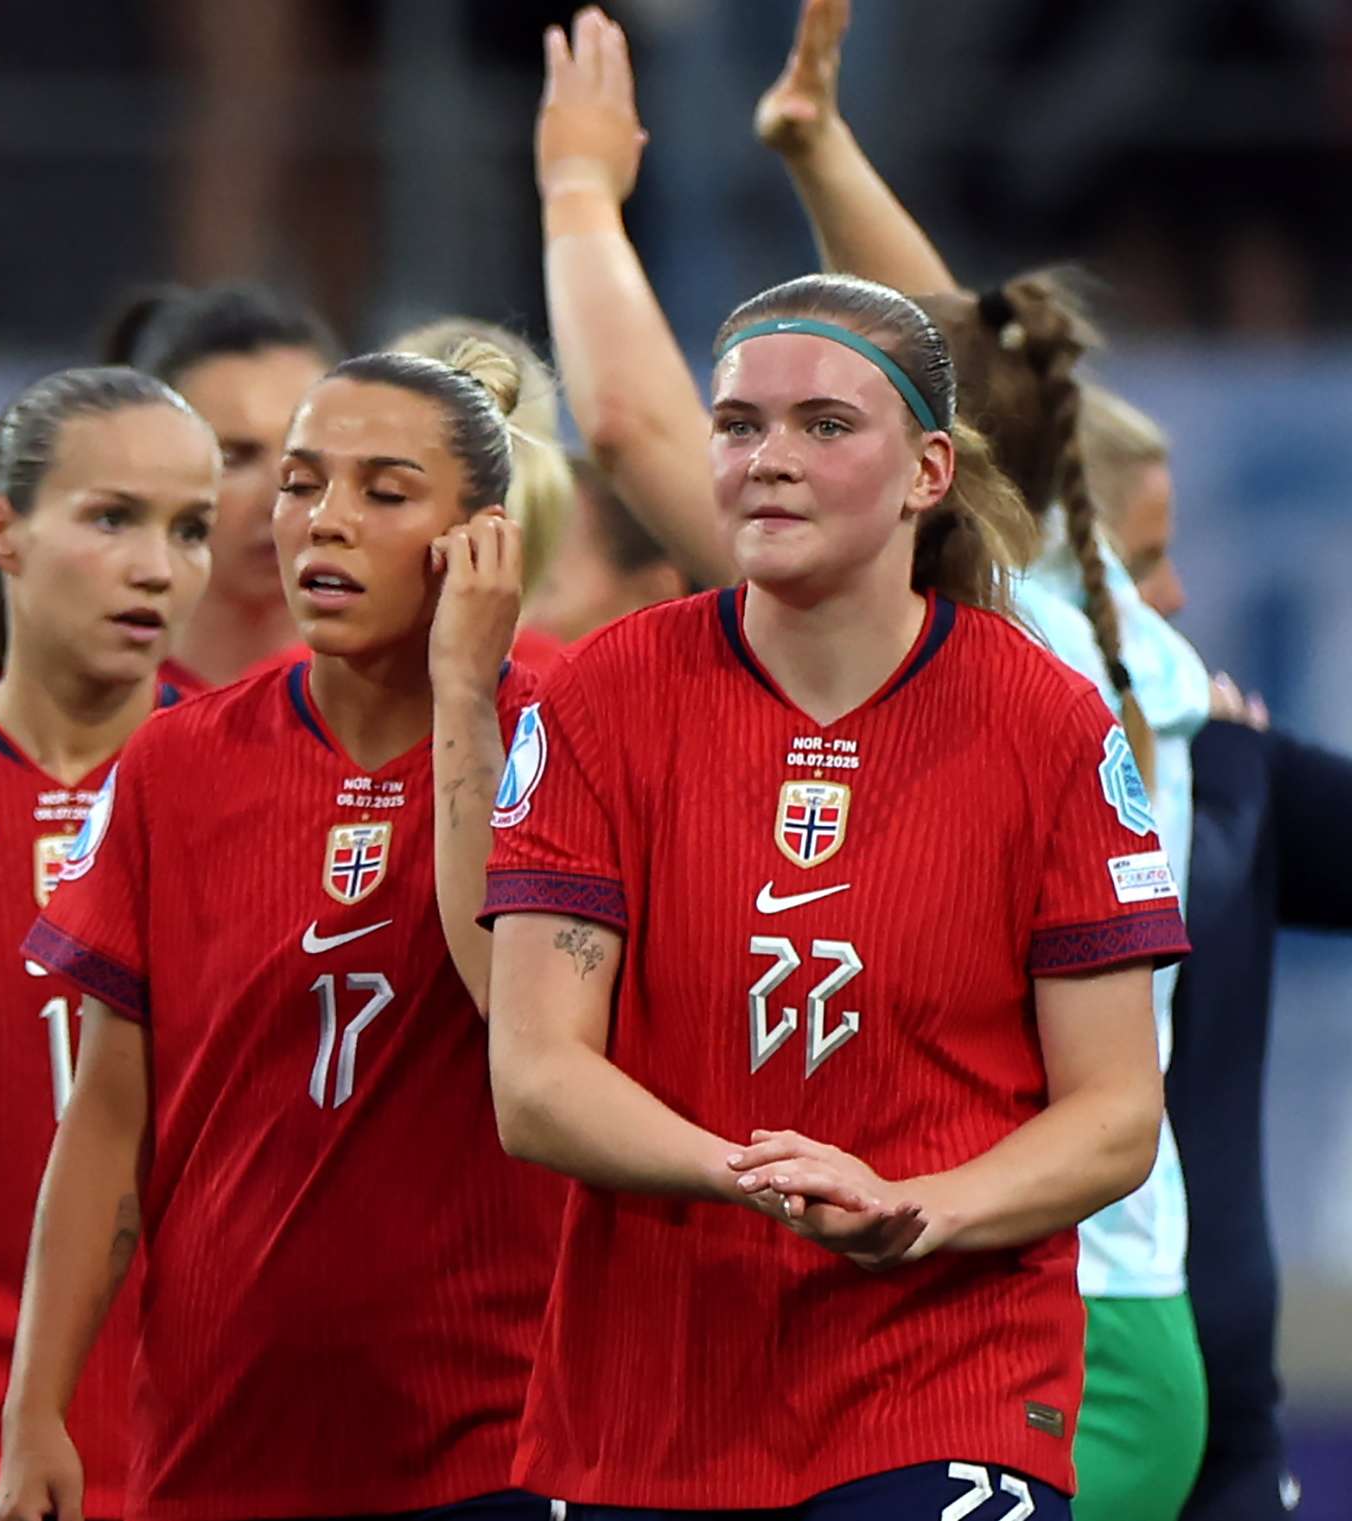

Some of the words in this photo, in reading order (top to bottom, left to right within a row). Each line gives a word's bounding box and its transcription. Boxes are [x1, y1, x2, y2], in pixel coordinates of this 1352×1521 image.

[793, 736, 823, 750] NOR
[833, 739, 857, 753] FIN
[344, 777, 372, 791] NOR
[382, 782, 404, 793] FIN
[309, 972, 395, 1109] 17
[749, 936, 864, 1080] 22
